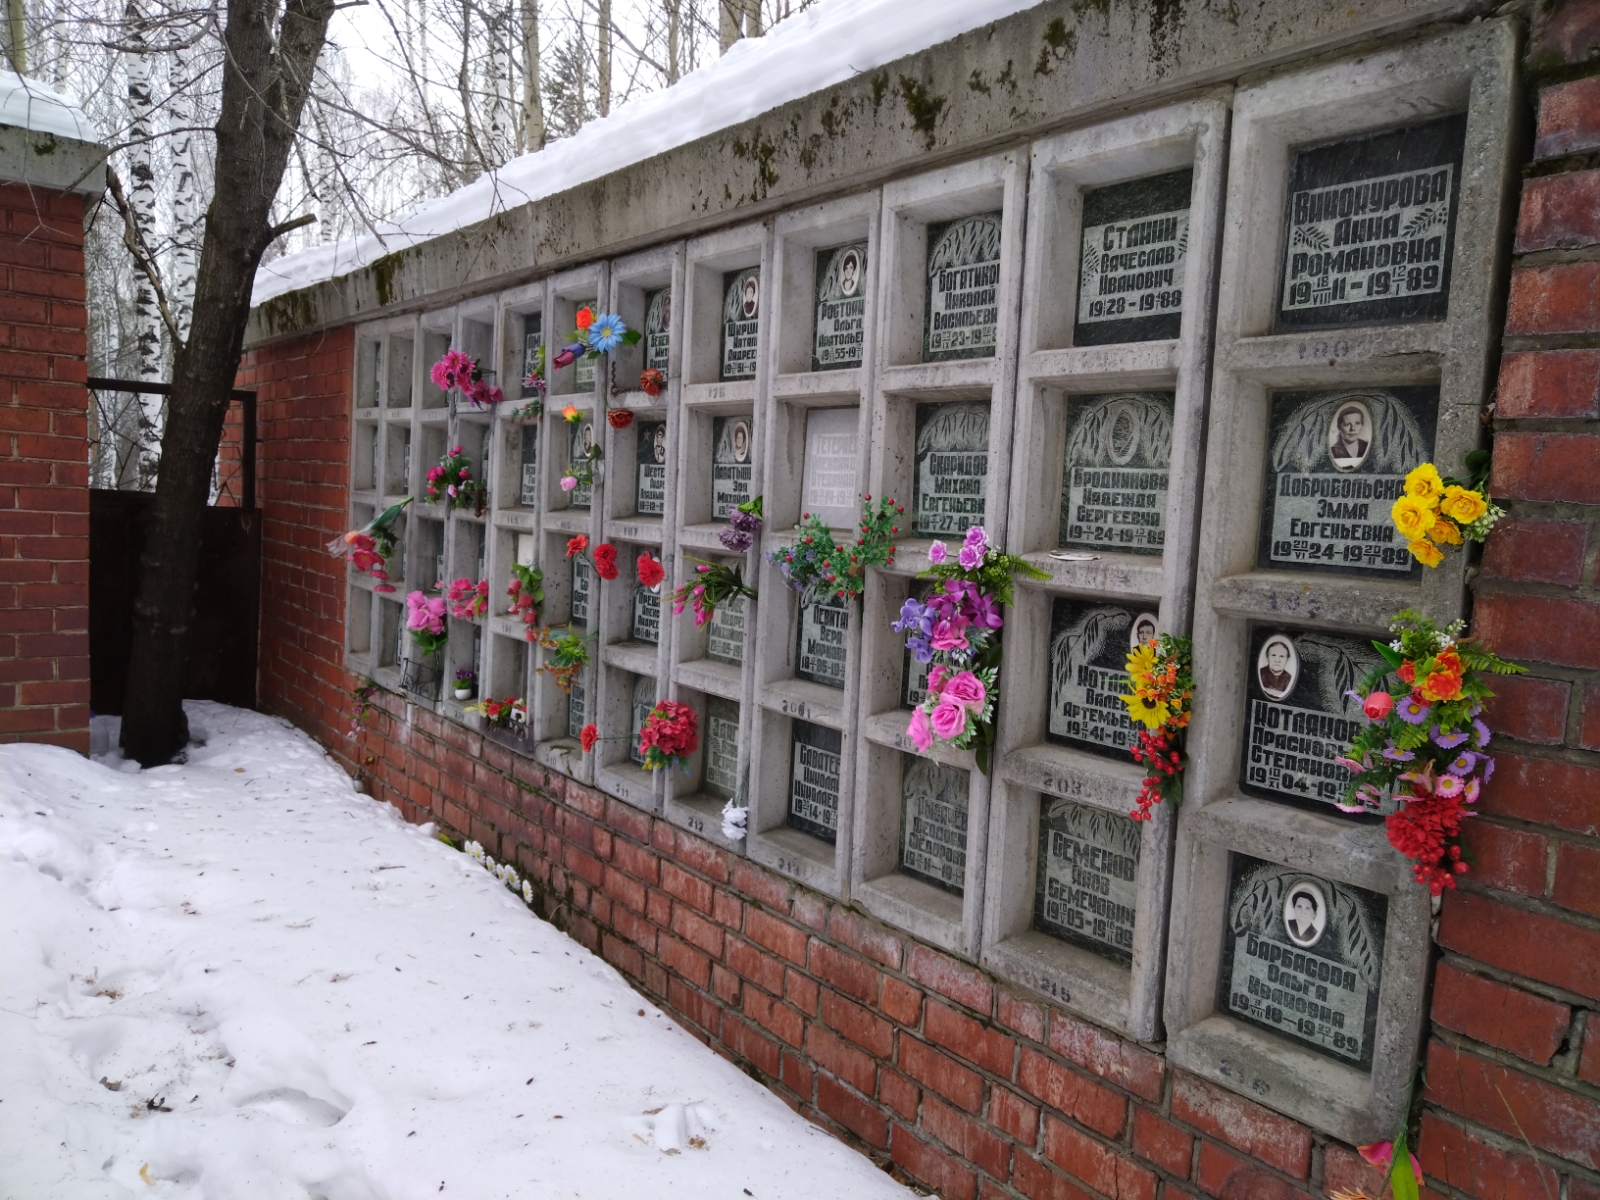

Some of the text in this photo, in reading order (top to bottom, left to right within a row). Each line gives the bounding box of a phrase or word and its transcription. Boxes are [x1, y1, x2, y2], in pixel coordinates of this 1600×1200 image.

[1294, 169, 1448, 226] ВИНОКУРОВА
[1333, 213, 1401, 247] АННА
[1101, 246, 1175, 273] ВЯЧЕСЛАВ
[1292, 235, 1442, 280] РОМАНОВНА
[1099, 268, 1174, 295] ИВАНОВИЧ
[1077, 505, 1160, 527] СЕРГЕЕВНА
[1290, 518, 1394, 542] ЕВГЕНЬЕВНА
[820, 625, 842, 644] ВЕРА
[1077, 664, 1136, 695] КОТЛЯ
[1251, 745, 1349, 782] СТЕПАНОВ
[688, 817, 704, 832] 212
[1052, 831, 1135, 882] СЕМЕНОВ
[1072, 864, 1110, 896] ЯКОВ
[1048, 877, 1136, 928] СЕМЕНОВИЧ
[1246, 933, 1357, 992] БАРБАСОВА
[1268, 964, 1328, 1002] ОЛЬГА
[1248, 975, 1345, 1029] ИВАНОВНА
